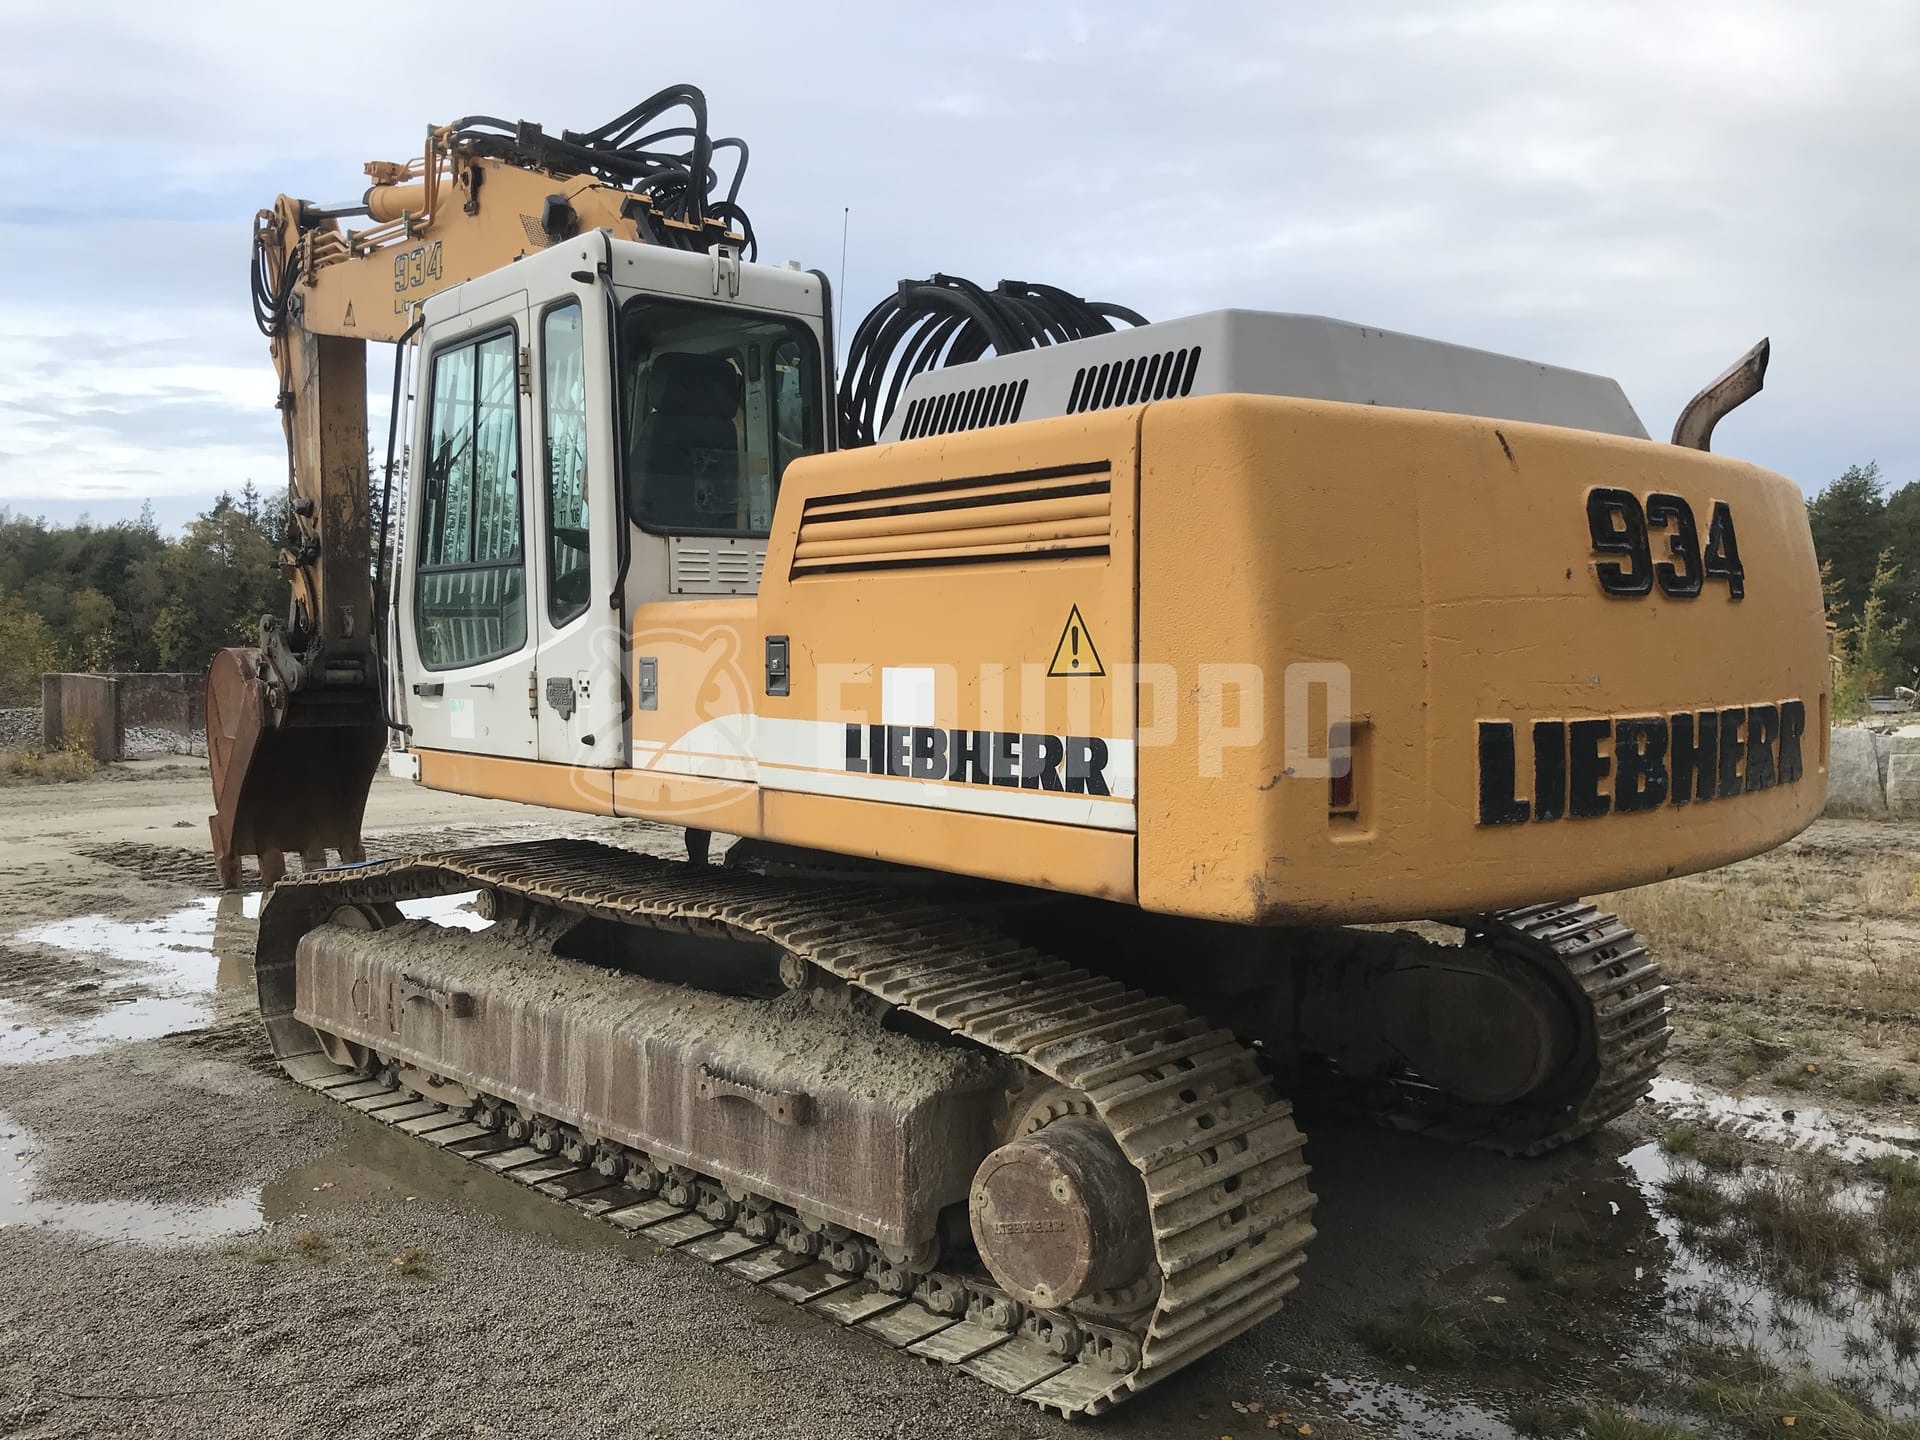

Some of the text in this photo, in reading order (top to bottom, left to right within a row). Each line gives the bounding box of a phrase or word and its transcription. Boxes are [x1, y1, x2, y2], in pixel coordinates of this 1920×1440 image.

[394, 240, 443, 292] 934
[1586, 487, 1745, 600] 934
[845, 723, 1111, 796] LIEBHERR
[1476, 699, 1805, 825] LIEBHERR
